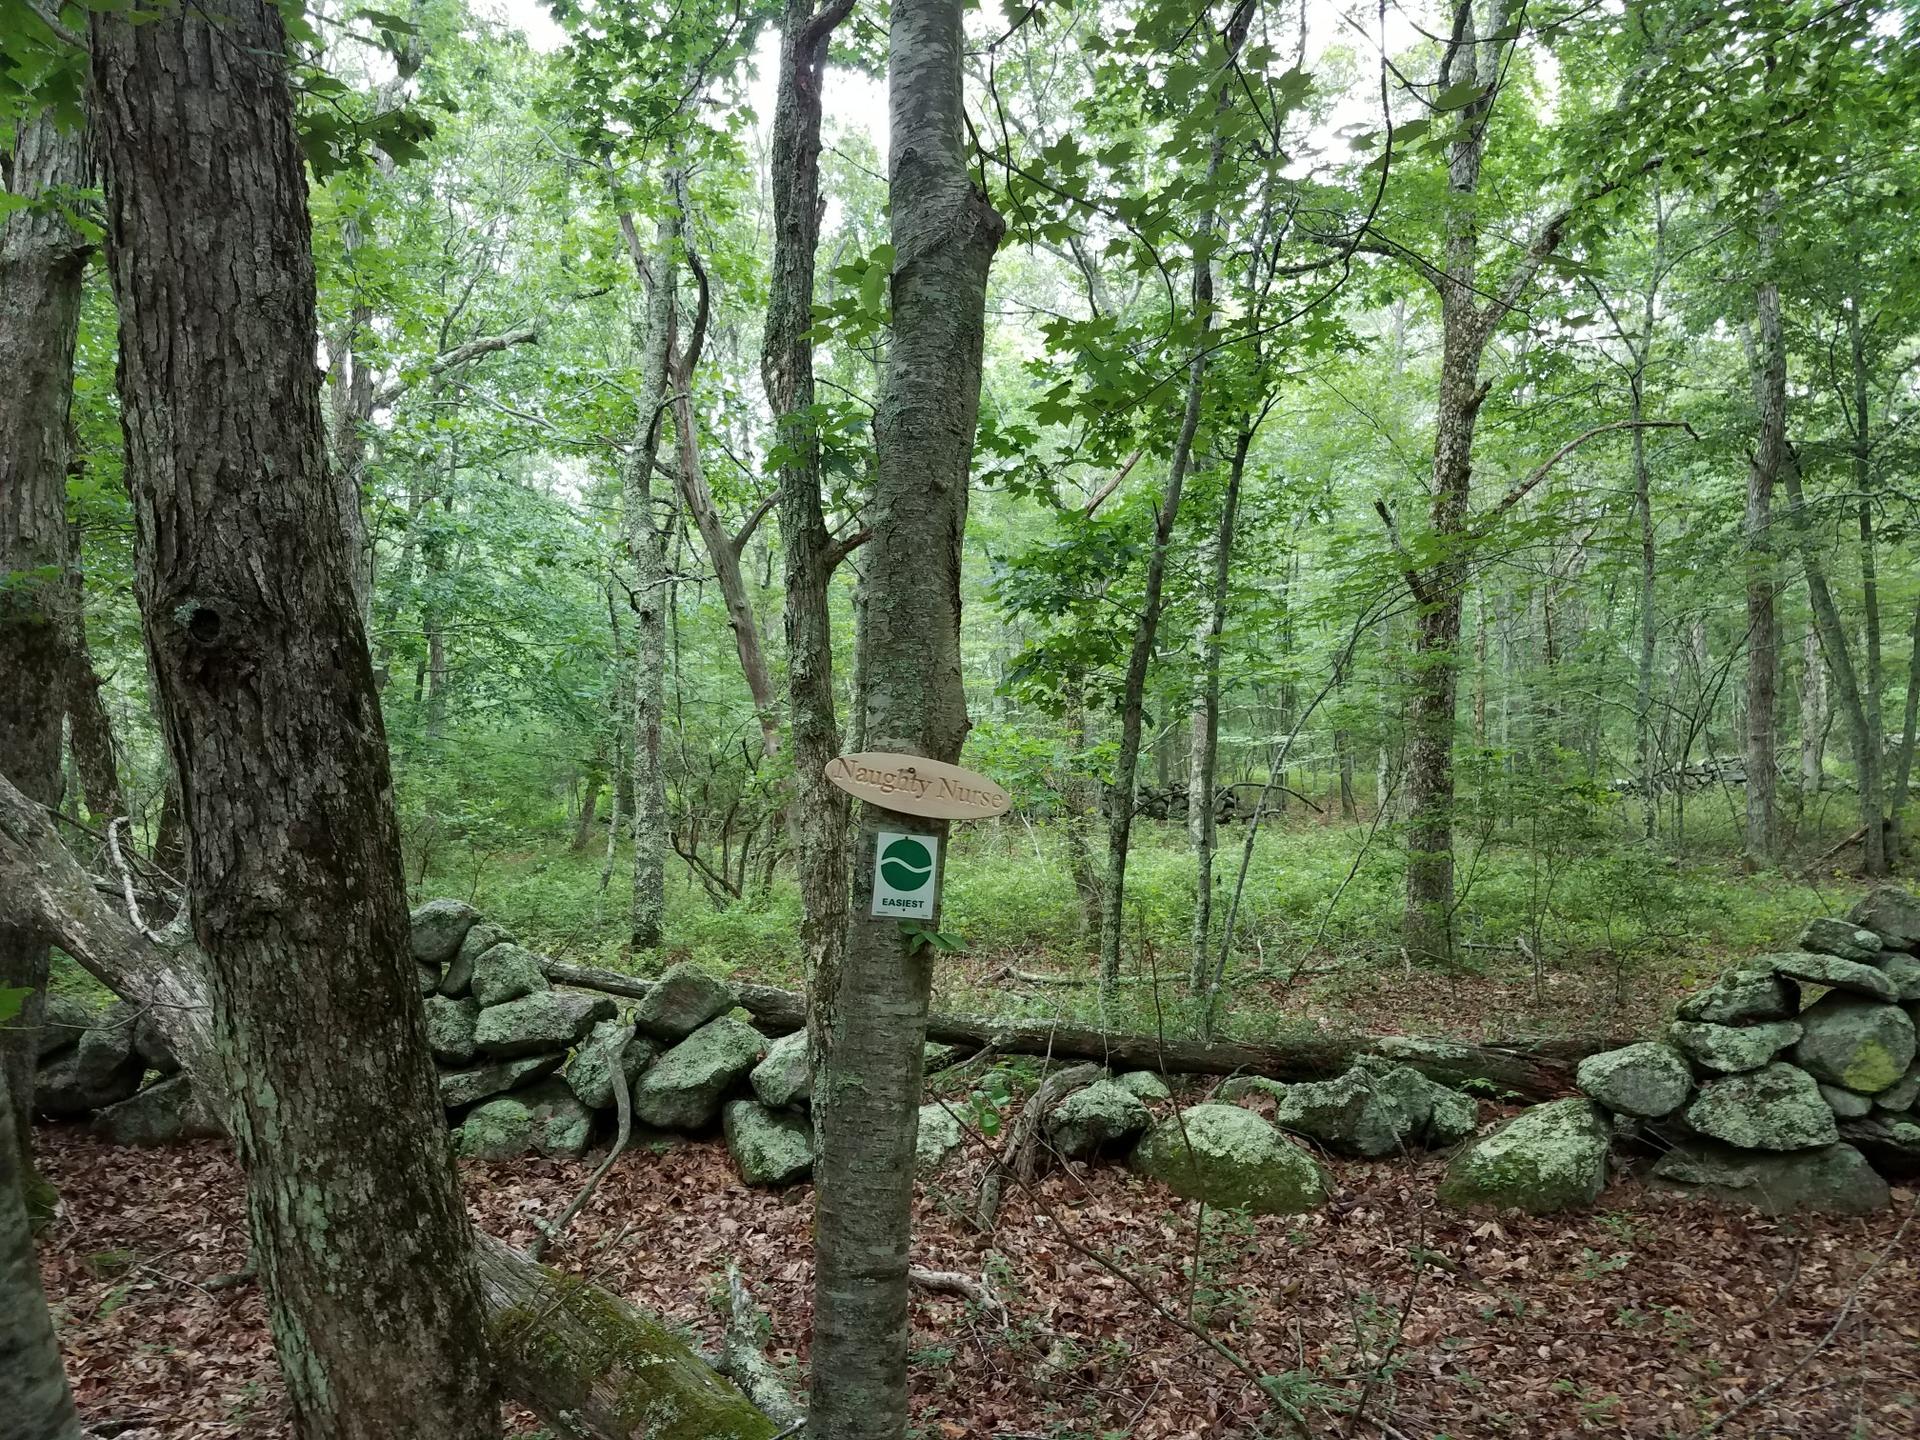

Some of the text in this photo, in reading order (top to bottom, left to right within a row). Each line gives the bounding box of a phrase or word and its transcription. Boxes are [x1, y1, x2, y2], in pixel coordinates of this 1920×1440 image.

[834, 757, 1003, 809] Naughty Nurse
[881, 898, 925, 909] EASIEST
